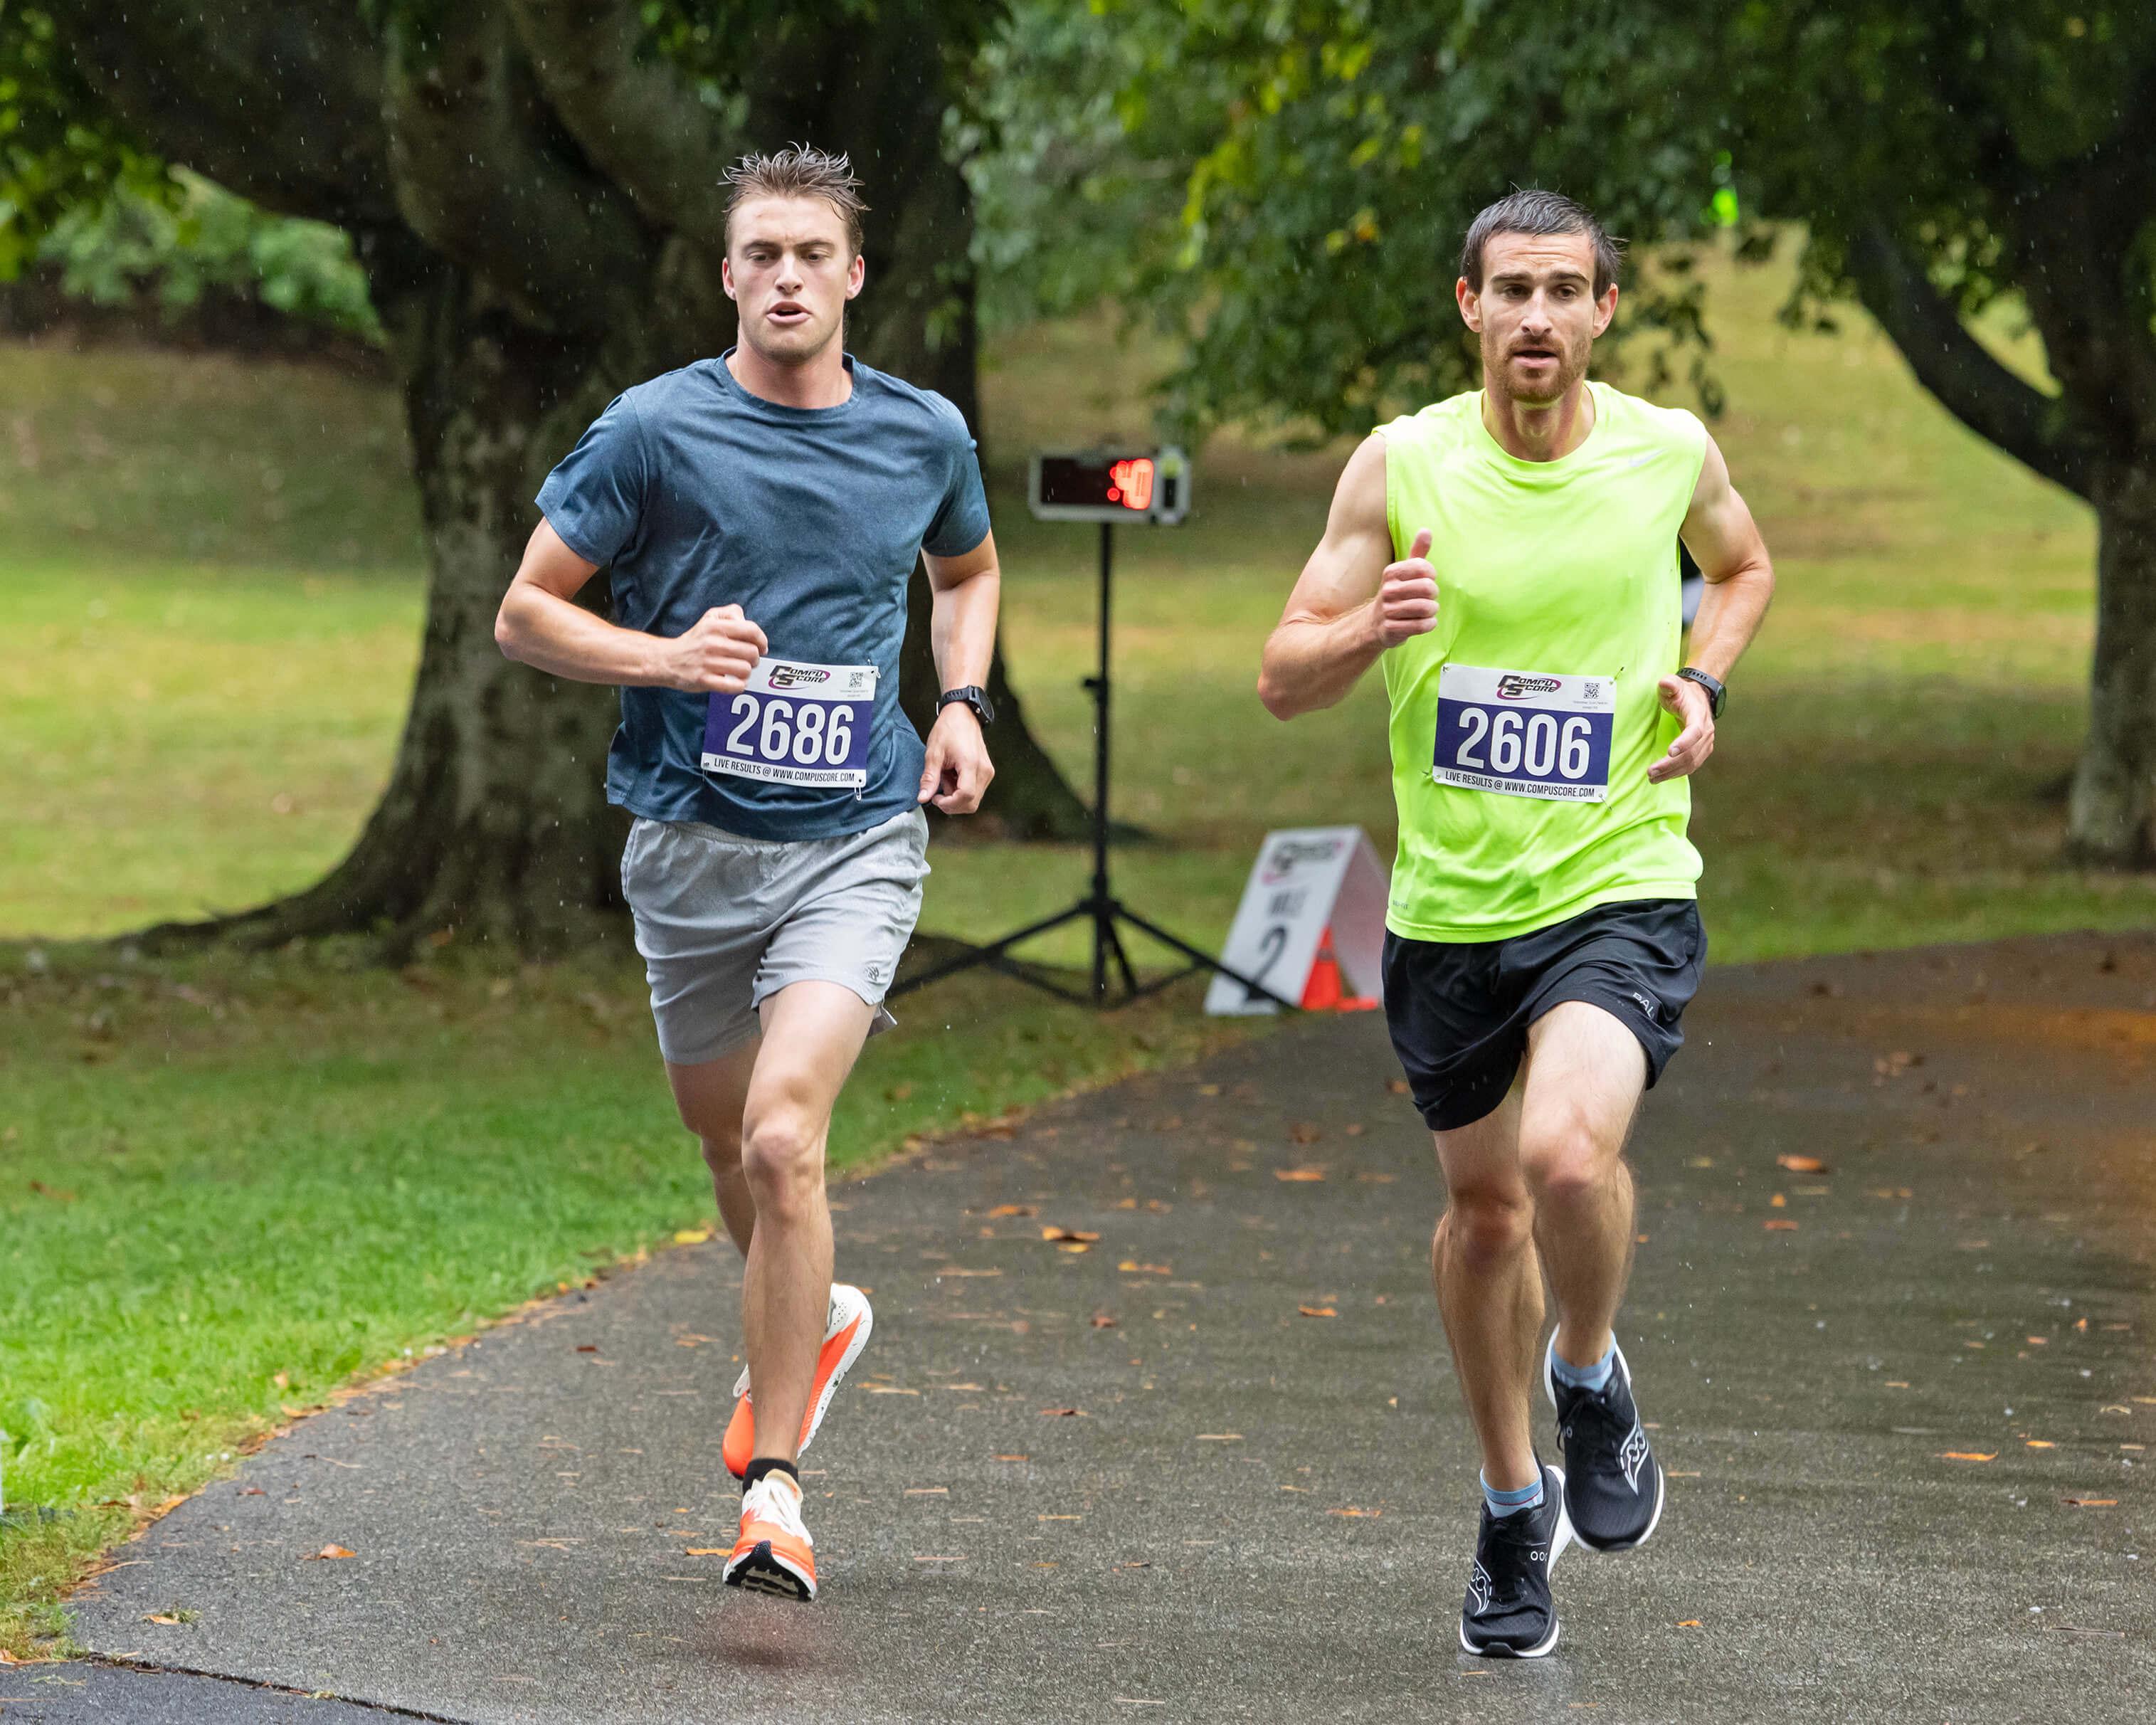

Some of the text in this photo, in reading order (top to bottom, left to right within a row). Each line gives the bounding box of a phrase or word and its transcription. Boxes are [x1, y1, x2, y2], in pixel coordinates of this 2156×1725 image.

[769, 665, 823, 677] COMPU
[775, 674, 826, 685] SCORE
[1498, 675, 1553, 687] COMPU
[1503, 684, 1557, 696] SCORE
[726, 694, 854, 765] 2686
[1457, 707, 1592, 779] 2606
[714, 757, 855, 782] LIVE RESULTS @ WWW.COMPUSCORE.COM
[1445, 771, 1595, 797] LIVE RESULTS @ WWW.COMPUSCORE.COM
[1244, 926, 1287, 1000] 2
